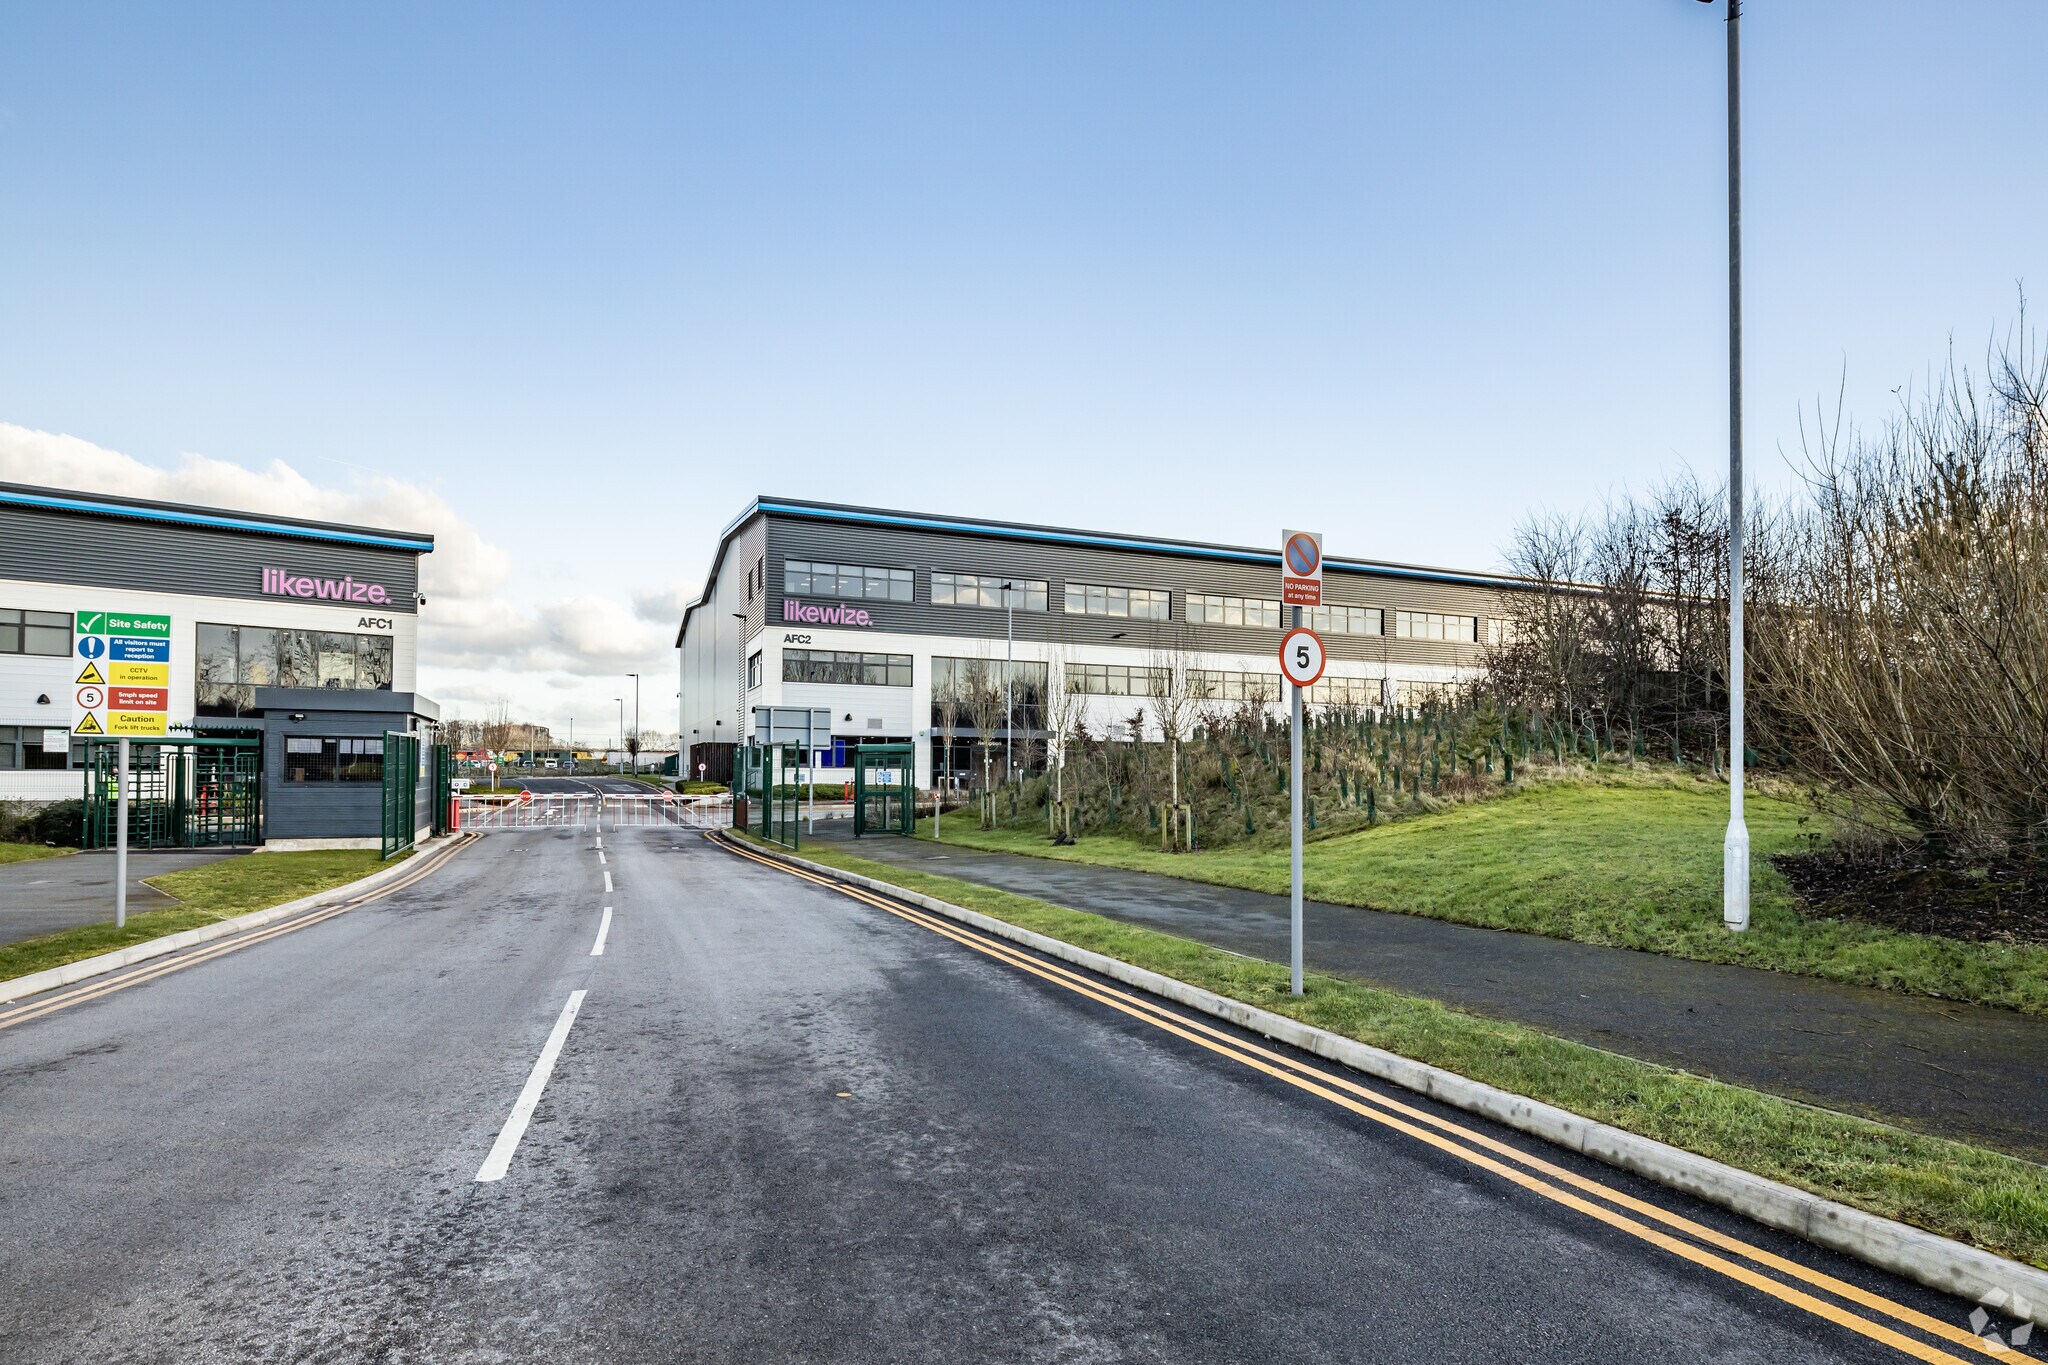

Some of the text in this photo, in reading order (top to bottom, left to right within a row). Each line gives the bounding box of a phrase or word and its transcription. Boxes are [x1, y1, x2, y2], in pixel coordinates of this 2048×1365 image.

[262, 568, 392, 604] likewize.
[1295, 584, 1319, 592] PARKING
[784, 600, 874, 626] likewize.
[109, 619, 168, 632] Site Safety
[358, 617, 392, 630] AFC1
[784, 634, 812, 644] AFC2
[1296, 646, 1310, 668] 5
[86, 693, 94, 702] 5
[120, 714, 154, 722] Caution
